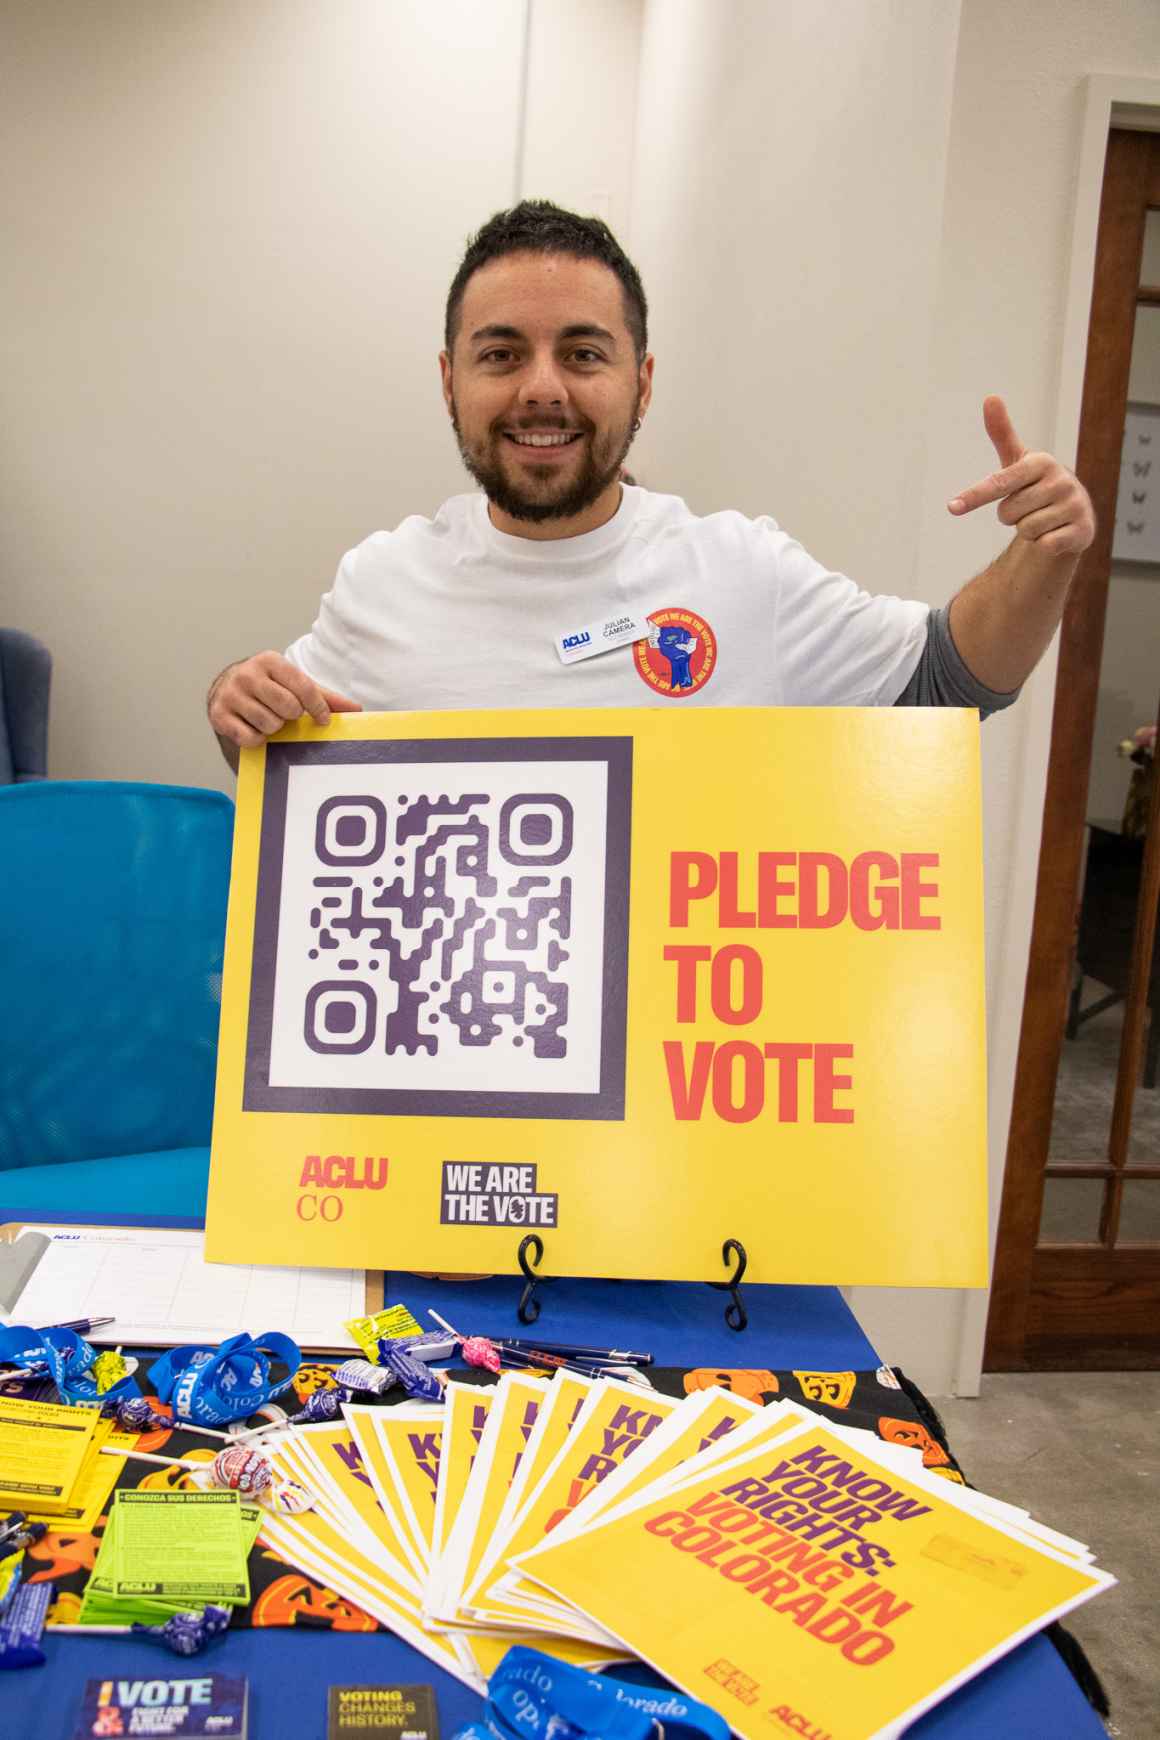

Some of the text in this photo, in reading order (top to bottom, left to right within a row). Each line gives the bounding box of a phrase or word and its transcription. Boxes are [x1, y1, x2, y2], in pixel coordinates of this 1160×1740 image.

[562, 631, 590, 649] ACLU
[602, 622, 636, 637] CAMERA
[604, 617, 630, 630] JULIAN
[669, 850, 941, 932] PLEDGE
[663, 944, 764, 1026] TO
[662, 1040, 855, 1124] VOTE
[298, 1155, 389, 1190] ACLU
[446, 1164, 533, 1193] WE ARE
[296, 1194, 344, 1223] CO
[444, 1194, 555, 1224] THE VOTE
[176, 1372, 199, 1419] ACLU
[761, 1460, 883, 1531] YOUR
[790, 1445, 934, 1521] KNOW
[719, 1476, 896, 1577] RIGHTS:
[685, 1491, 855, 1593] VOTING
[839, 1581, 915, 1629] IN
[643, 1511, 895, 1666] COLORADO
[118, 1678, 214, 1707] VOTE
[339, 1701, 416, 1714] CHANGES
[340, 1691, 402, 1702] VOTING
